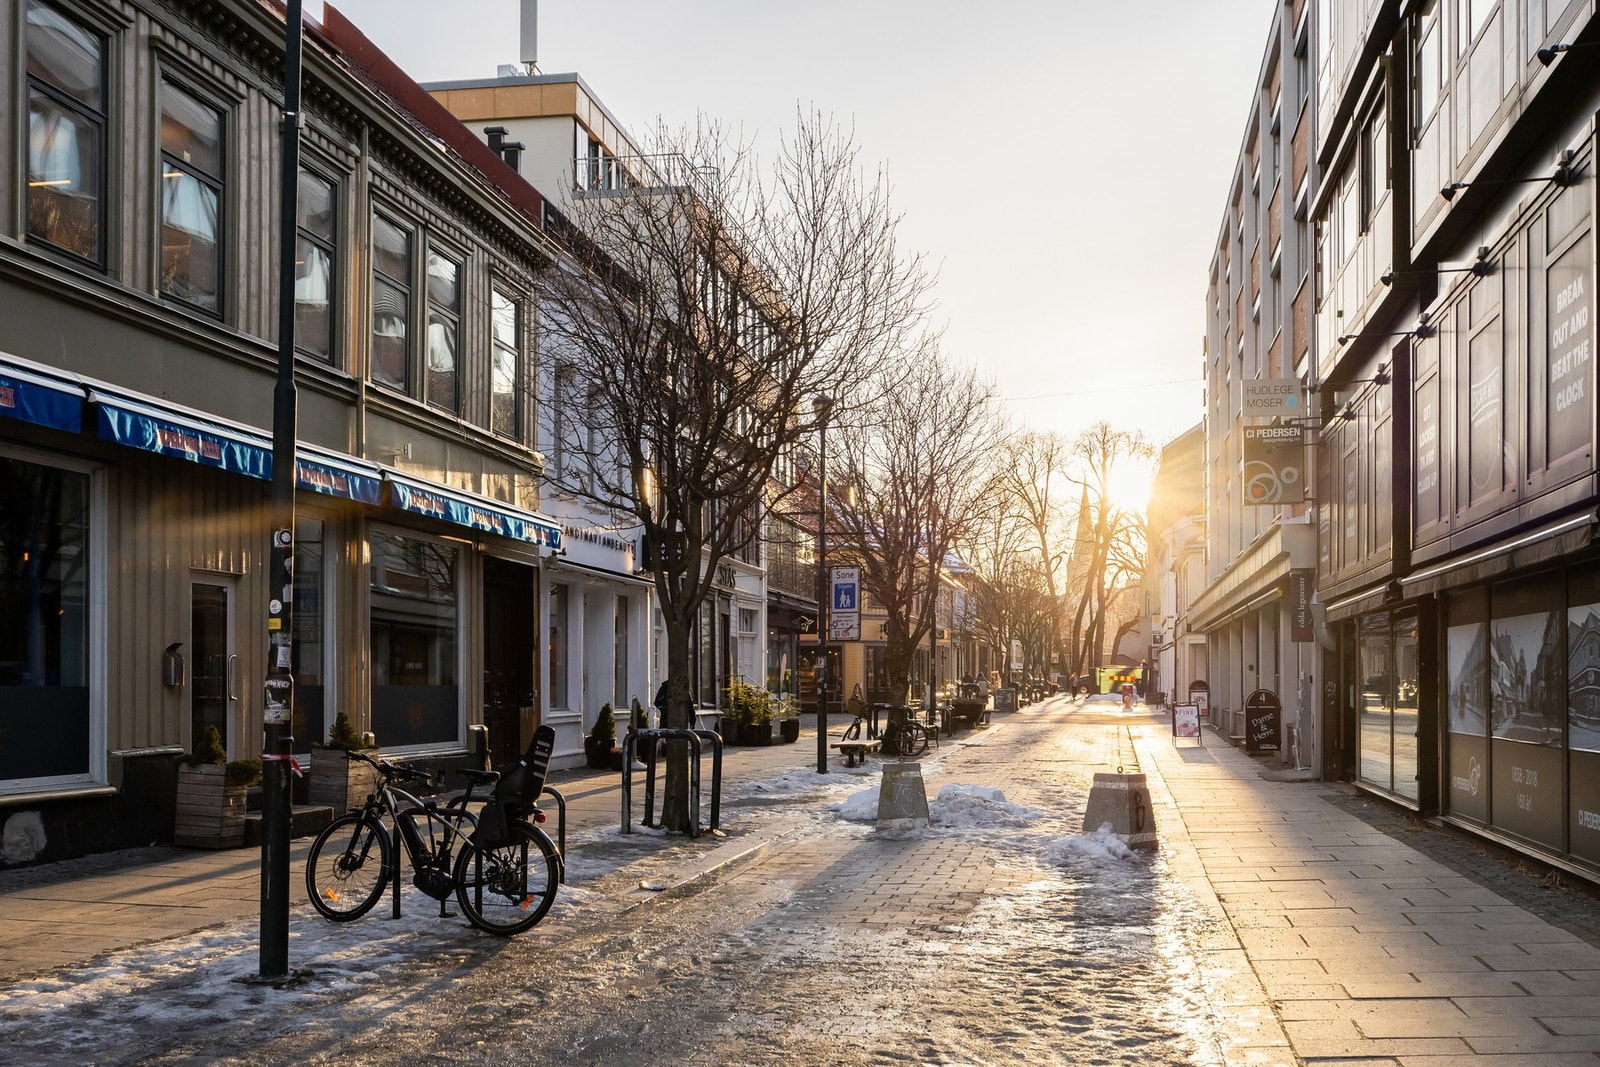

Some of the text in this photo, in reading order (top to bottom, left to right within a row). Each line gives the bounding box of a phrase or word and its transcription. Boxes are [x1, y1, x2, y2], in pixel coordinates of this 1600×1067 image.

[1557, 273, 1584, 314] BREAK
[1553, 306, 1588, 349] OUT AND
[1552, 339, 1589, 383] BEAT THE
[1246, 385, 1294, 395] HUDLEGE
[1556, 377, 1584, 412] CLOCK
[1246, 398, 1283, 408] MOSER
[1246, 427, 1300, 439] CI PEDERSEN
[836, 571, 854, 579] Sone
[1298, 577, 1308, 610] legesenter
[1259, 693, 1266, 702] 4
[1251, 712, 1275, 727] Dame
[1252, 728, 1275, 742] Herre
[1260, 724, 1268, 732] &
